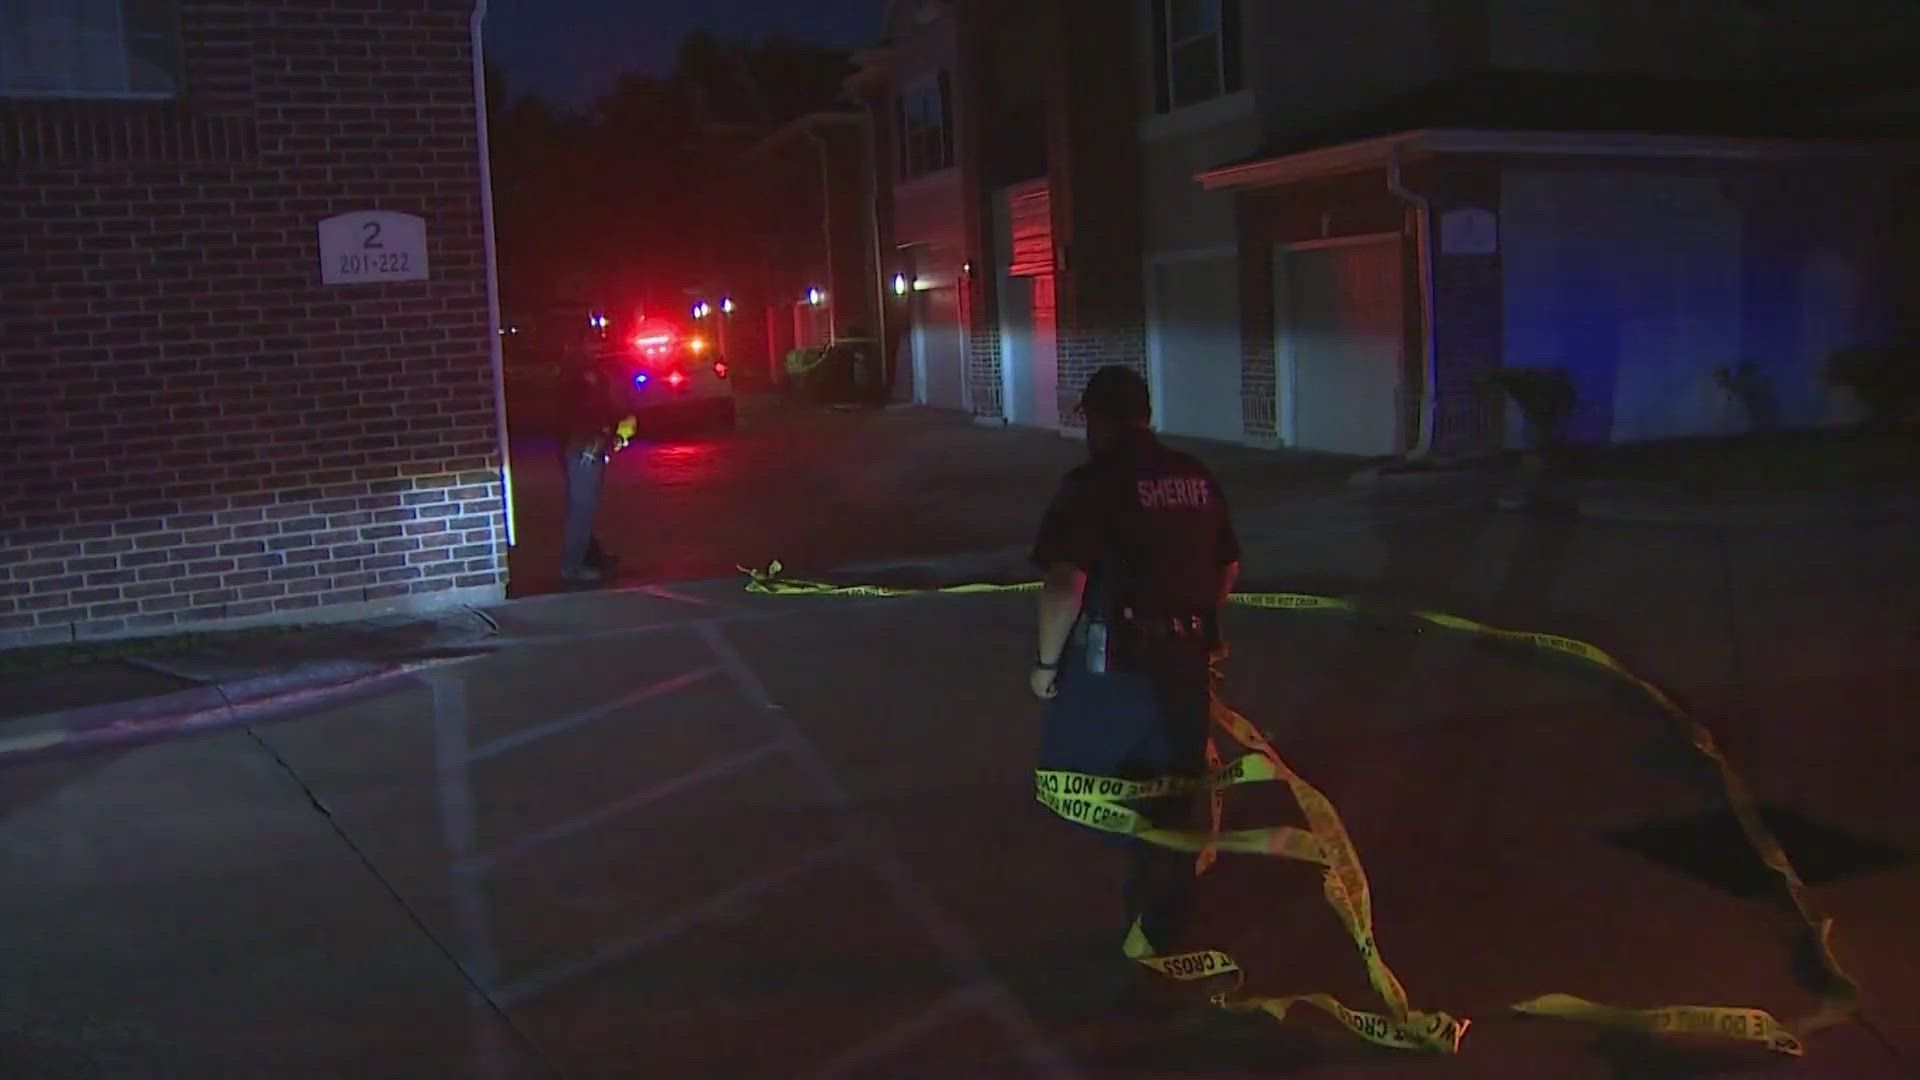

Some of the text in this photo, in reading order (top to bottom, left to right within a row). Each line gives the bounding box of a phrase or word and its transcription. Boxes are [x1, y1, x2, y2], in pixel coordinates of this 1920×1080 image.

[363, 221, 383, 249] 2
[340, 253, 411, 274] 201-222
[1137, 478, 1208, 506] SHERIFF
[1063, 775, 1094, 796] NOT
[1100, 778, 1123, 796] DO
[1062, 799, 1092, 818] NOT
[1164, 952, 1215, 977] CROSS
